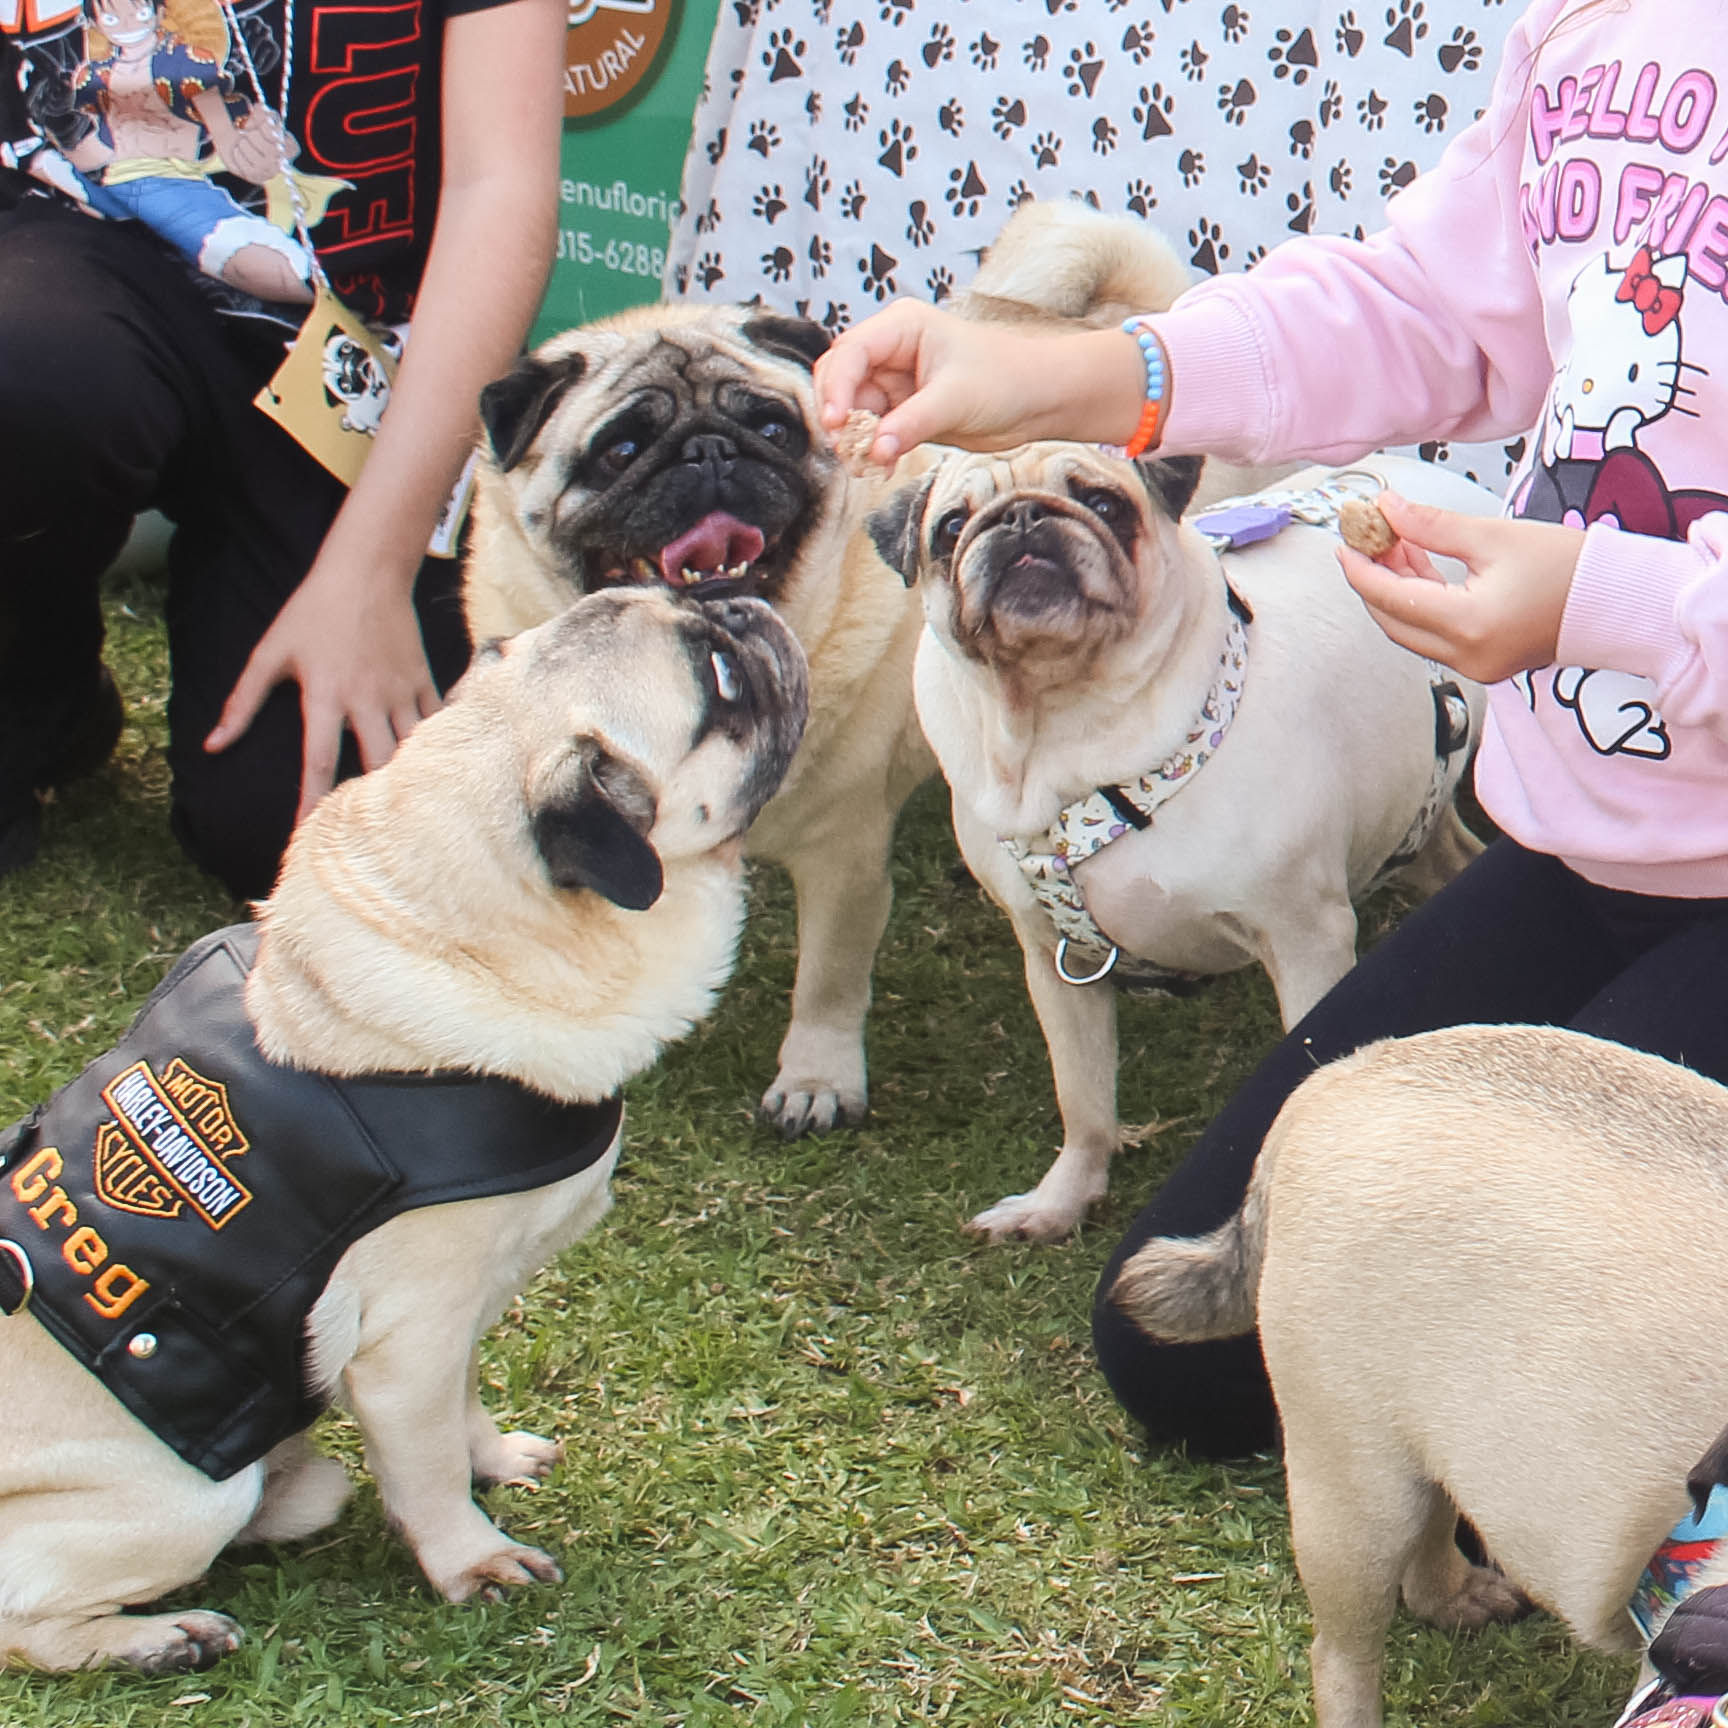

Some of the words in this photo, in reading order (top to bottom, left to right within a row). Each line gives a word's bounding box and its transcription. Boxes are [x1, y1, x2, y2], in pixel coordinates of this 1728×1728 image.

[563, 27, 646, 97] ATURAL
[1529, 59, 1717, 166] HELLO
[112, 1071, 242, 1217] HARLEY-DAVIDSON
[166, 1069, 234, 1156] MOTOR
[102, 1130, 172, 1212] CYCLES
[11, 1146, 150, 1319] Greg
